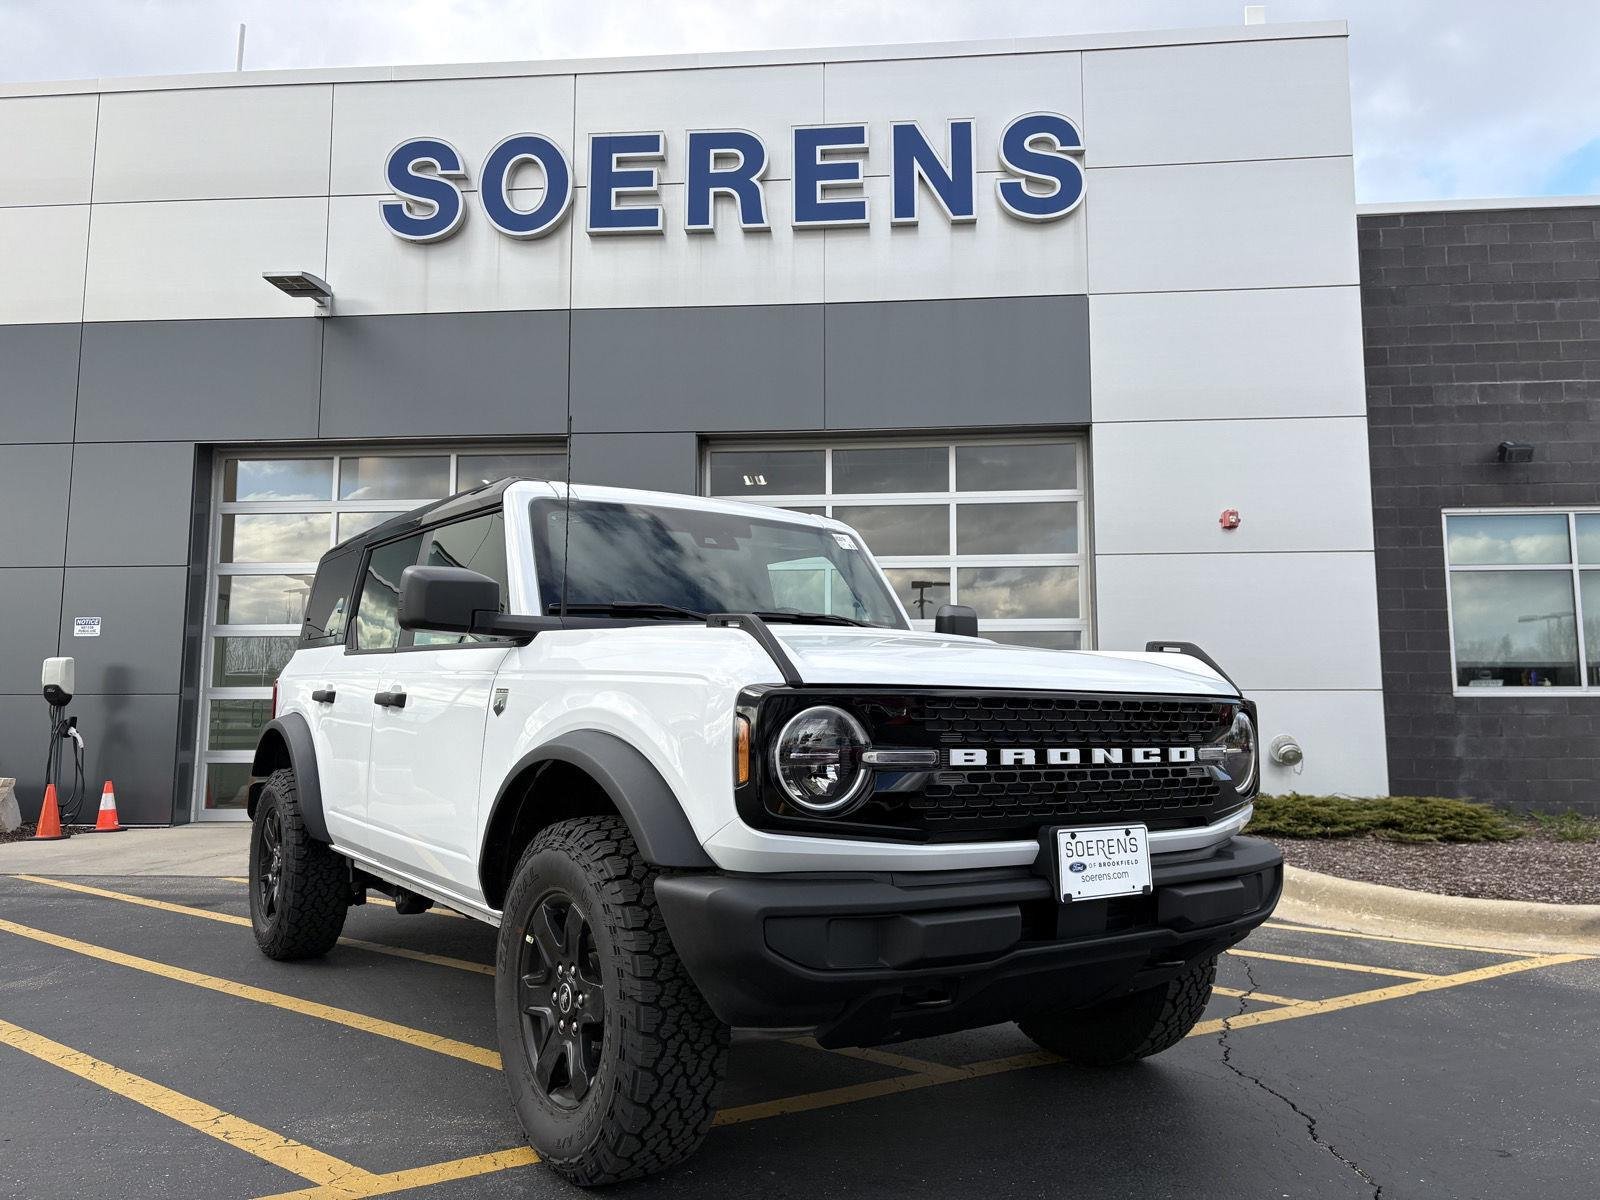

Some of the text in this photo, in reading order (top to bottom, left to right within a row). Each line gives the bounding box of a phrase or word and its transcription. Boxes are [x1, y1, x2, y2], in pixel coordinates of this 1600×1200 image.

[379, 111, 1087, 242] SOERENS
[949, 748, 1196, 766] BRONCO
[1066, 838, 1138, 860] SOERENS
[1098, 859, 1139, 868] BROOKFIELD
[1081, 871, 1130, 883] soerens.com
